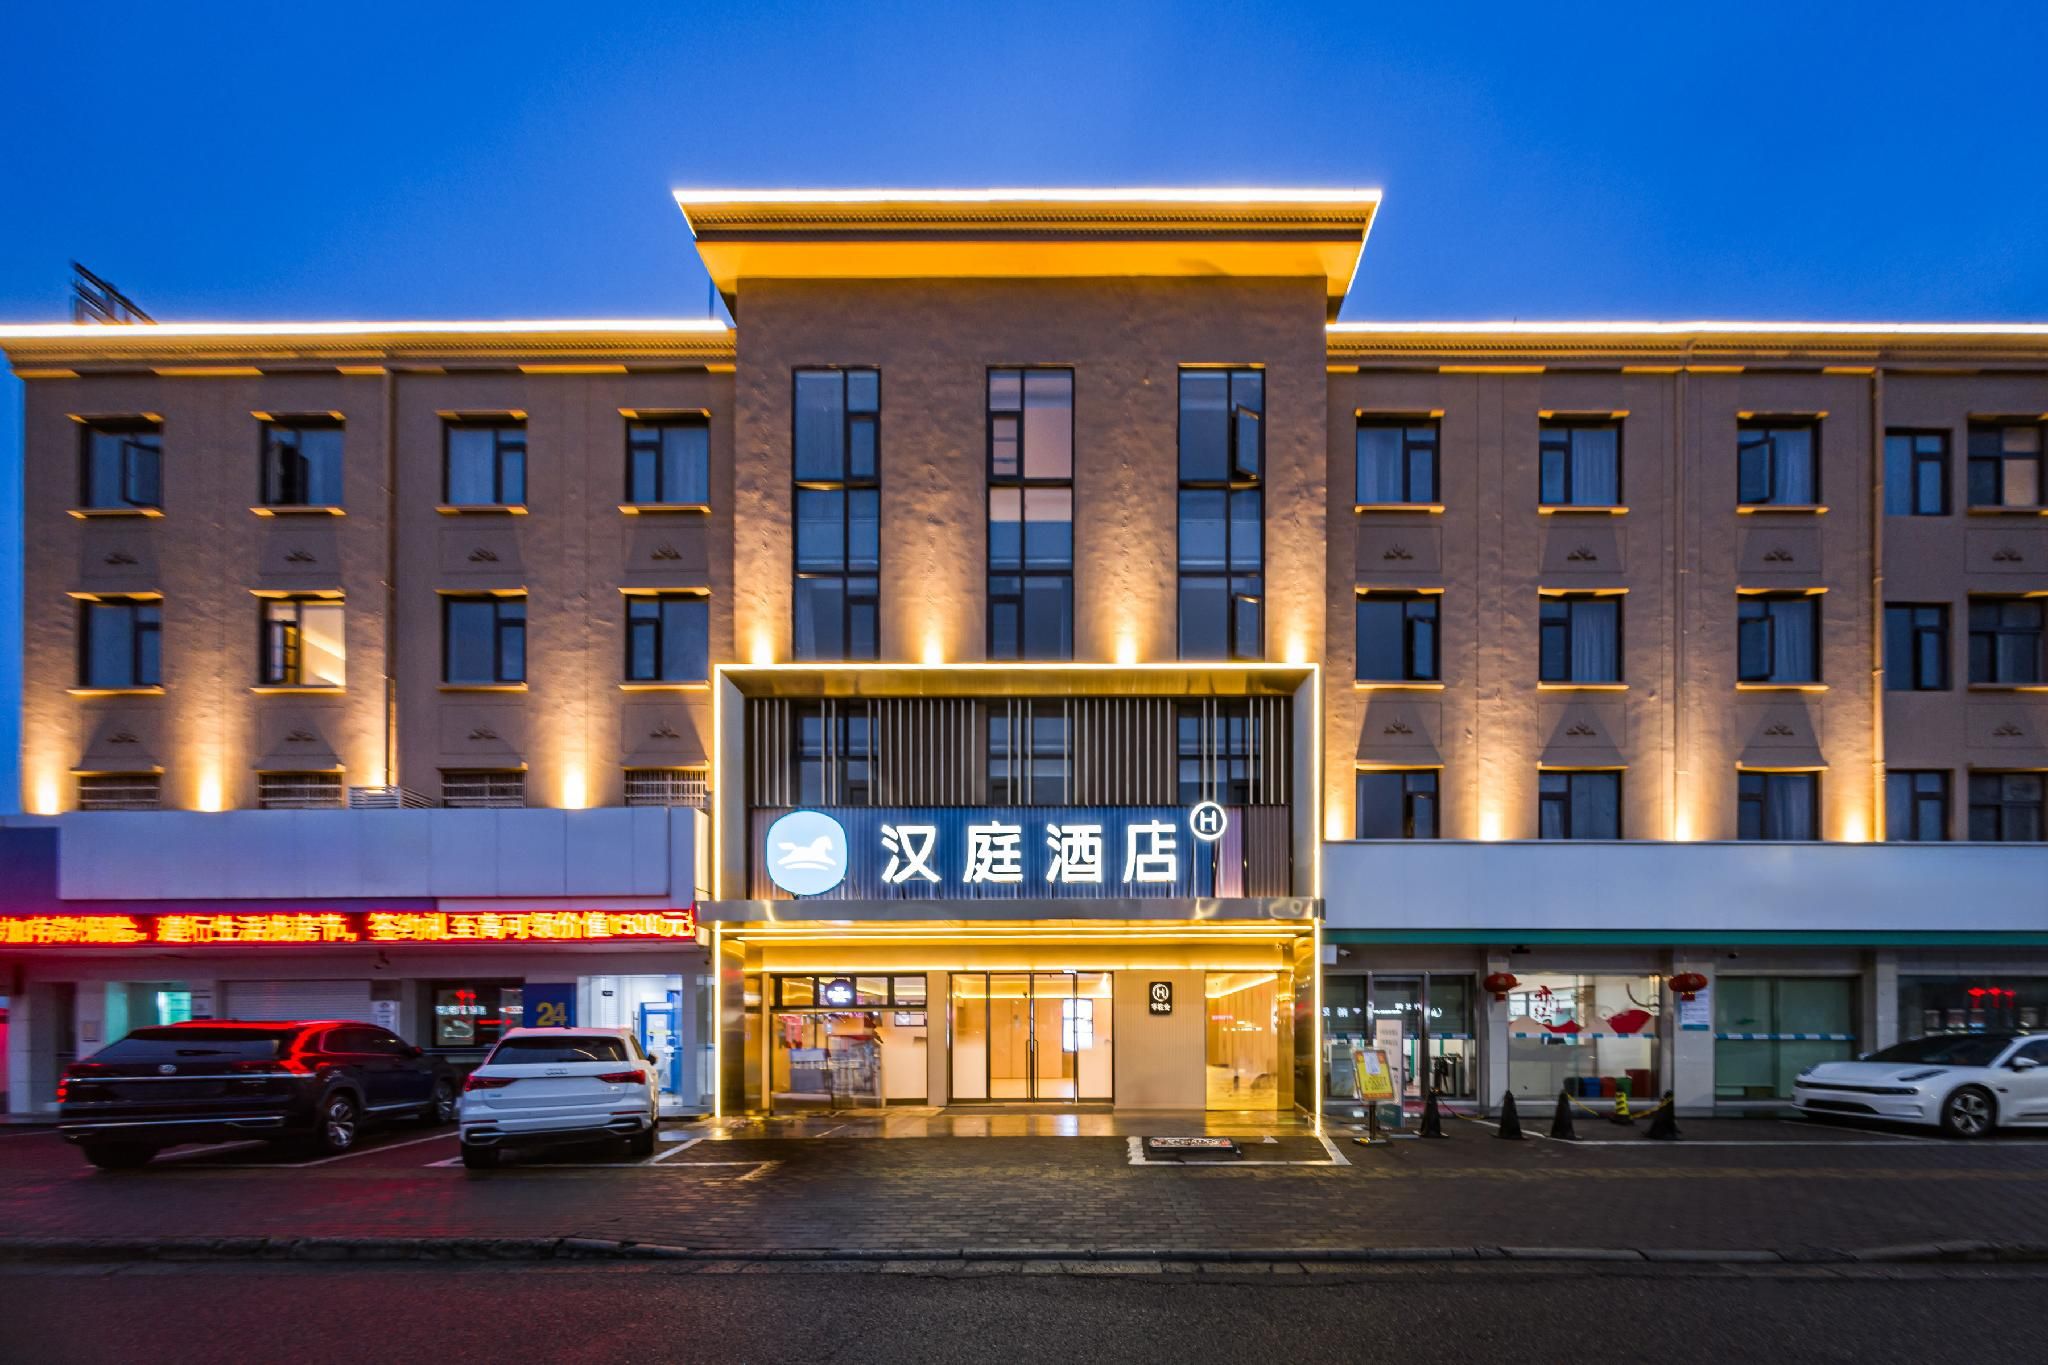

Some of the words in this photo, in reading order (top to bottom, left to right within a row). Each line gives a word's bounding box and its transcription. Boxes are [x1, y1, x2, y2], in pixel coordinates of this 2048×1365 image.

[881, 820, 1178, 883] 汉庭酒店
[536, 1002, 567, 1026] 24
